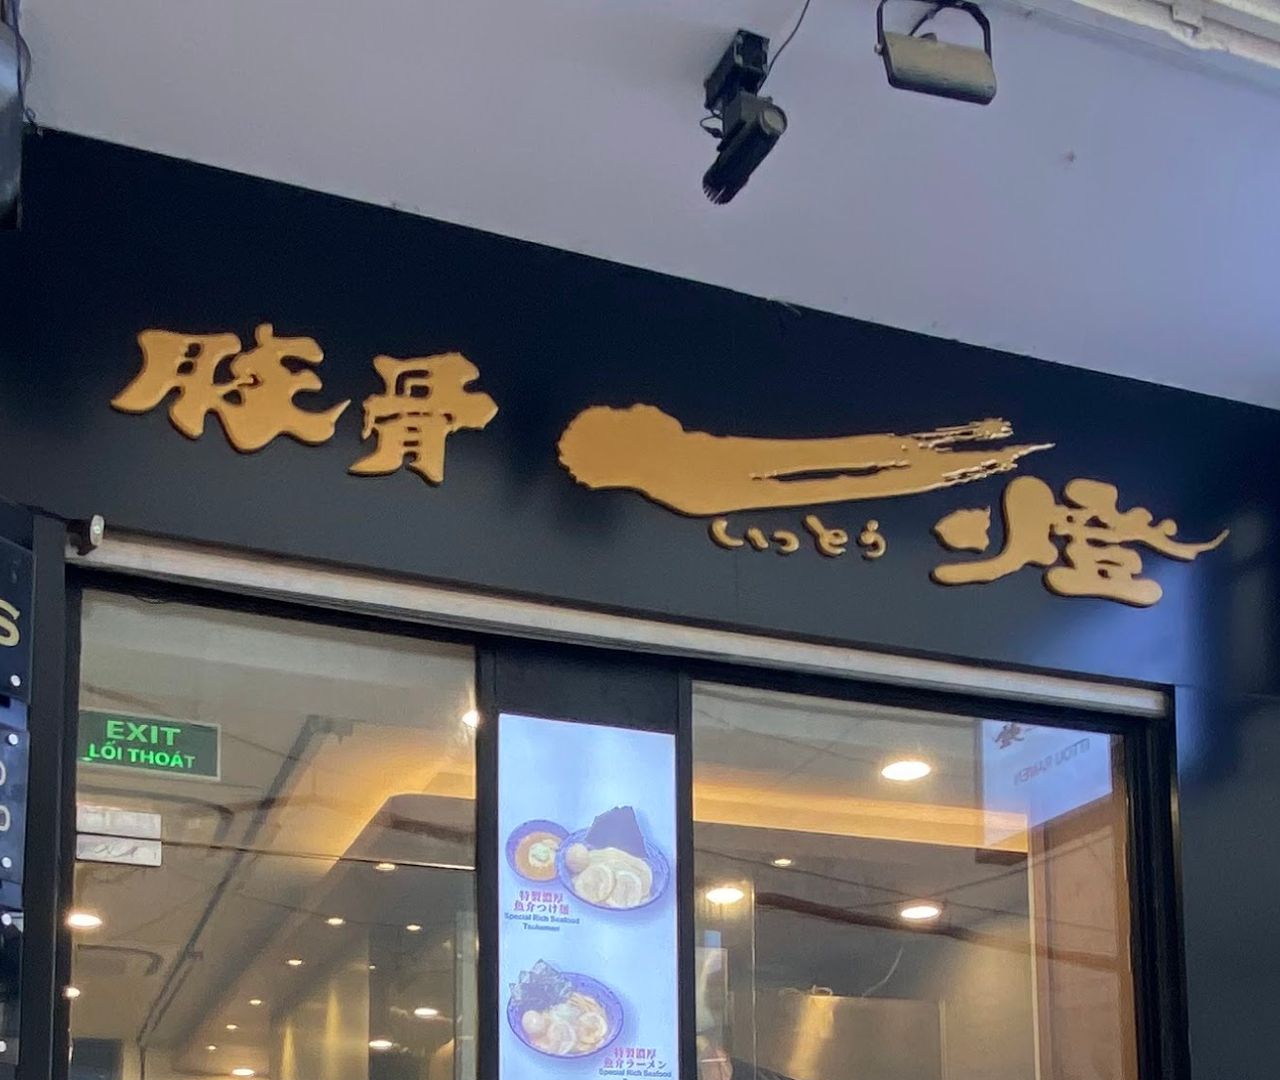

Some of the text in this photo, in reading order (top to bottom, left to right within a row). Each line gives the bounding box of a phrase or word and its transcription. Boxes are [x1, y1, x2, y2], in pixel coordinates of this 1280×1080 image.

[710, 514, 887, 560] いっとう
[106, 719, 181, 746] EXIT
[89, 740, 196, 769] LỐI THOÁT
